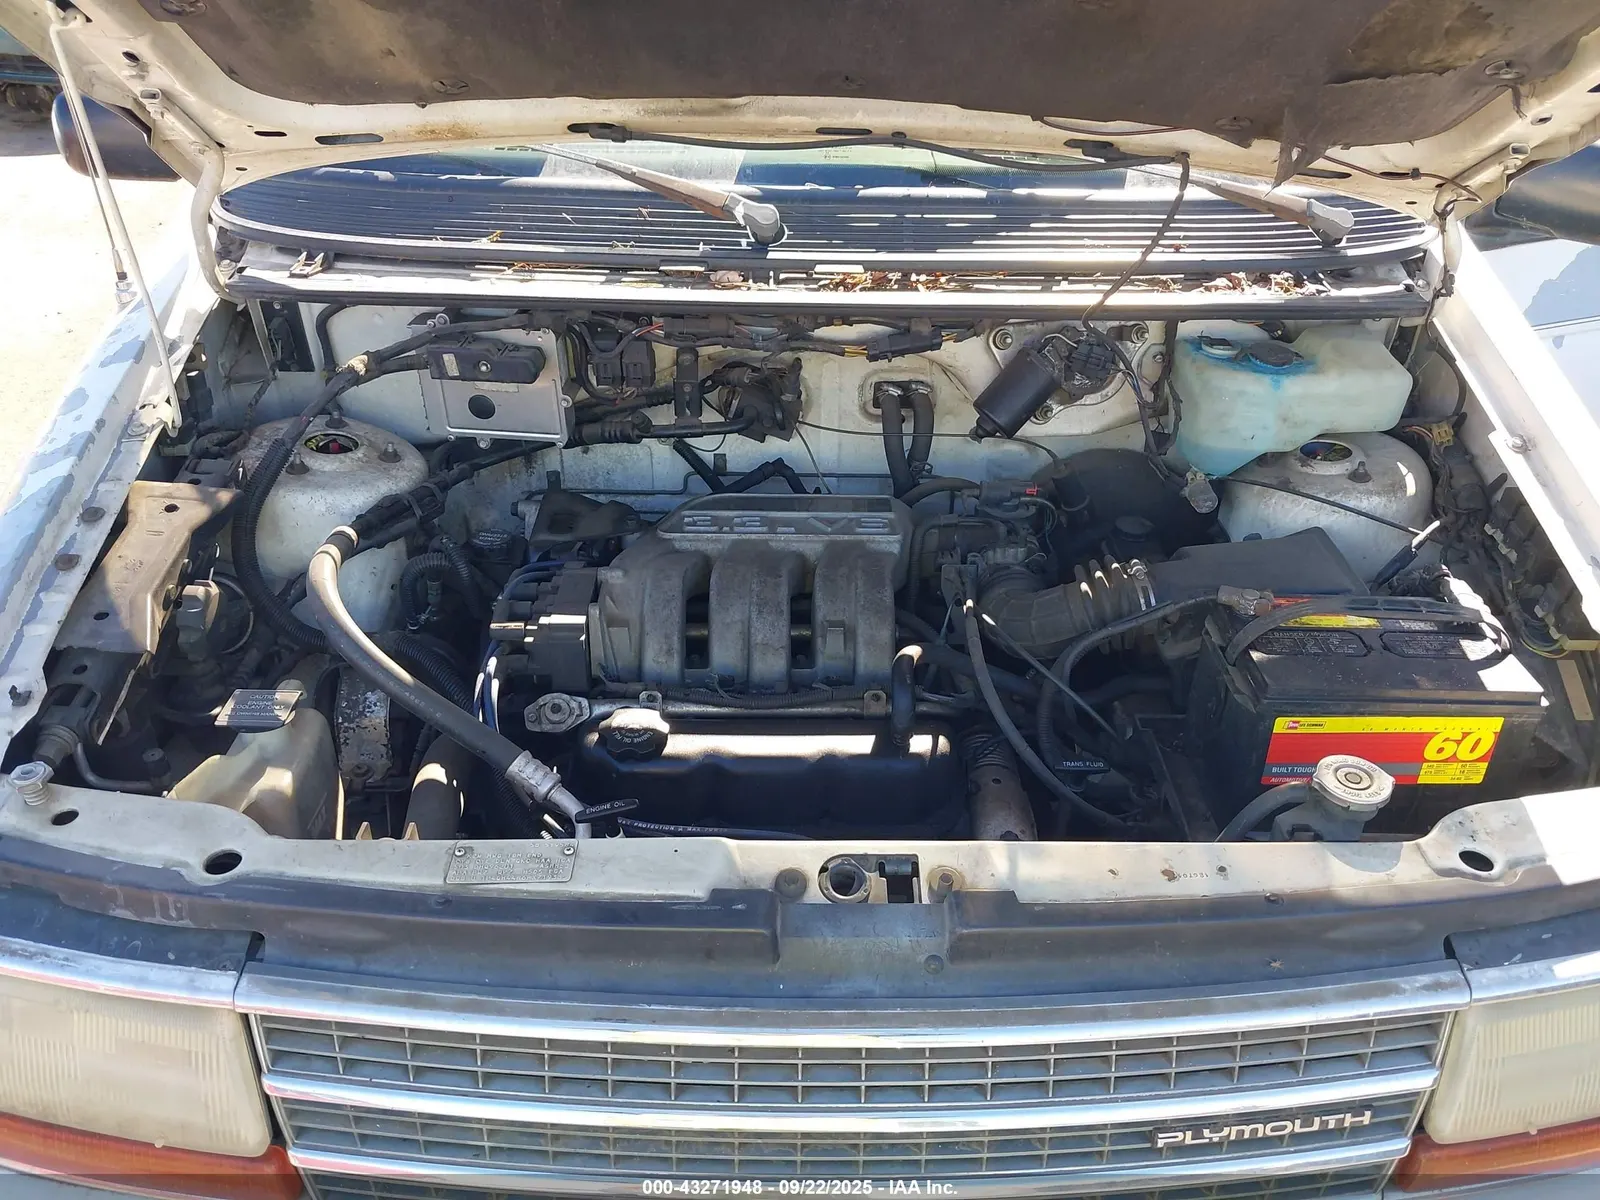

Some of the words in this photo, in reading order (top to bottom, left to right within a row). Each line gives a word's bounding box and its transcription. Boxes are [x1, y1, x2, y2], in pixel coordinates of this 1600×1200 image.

[1423, 731, 1496, 761] 60
[585, 803, 611, 815] ENGINE
[614, 800, 626, 808] OIL
[633, 822, 675, 831] PROTECTION
[1156, 1110, 1372, 1148] PLYMOUTH
